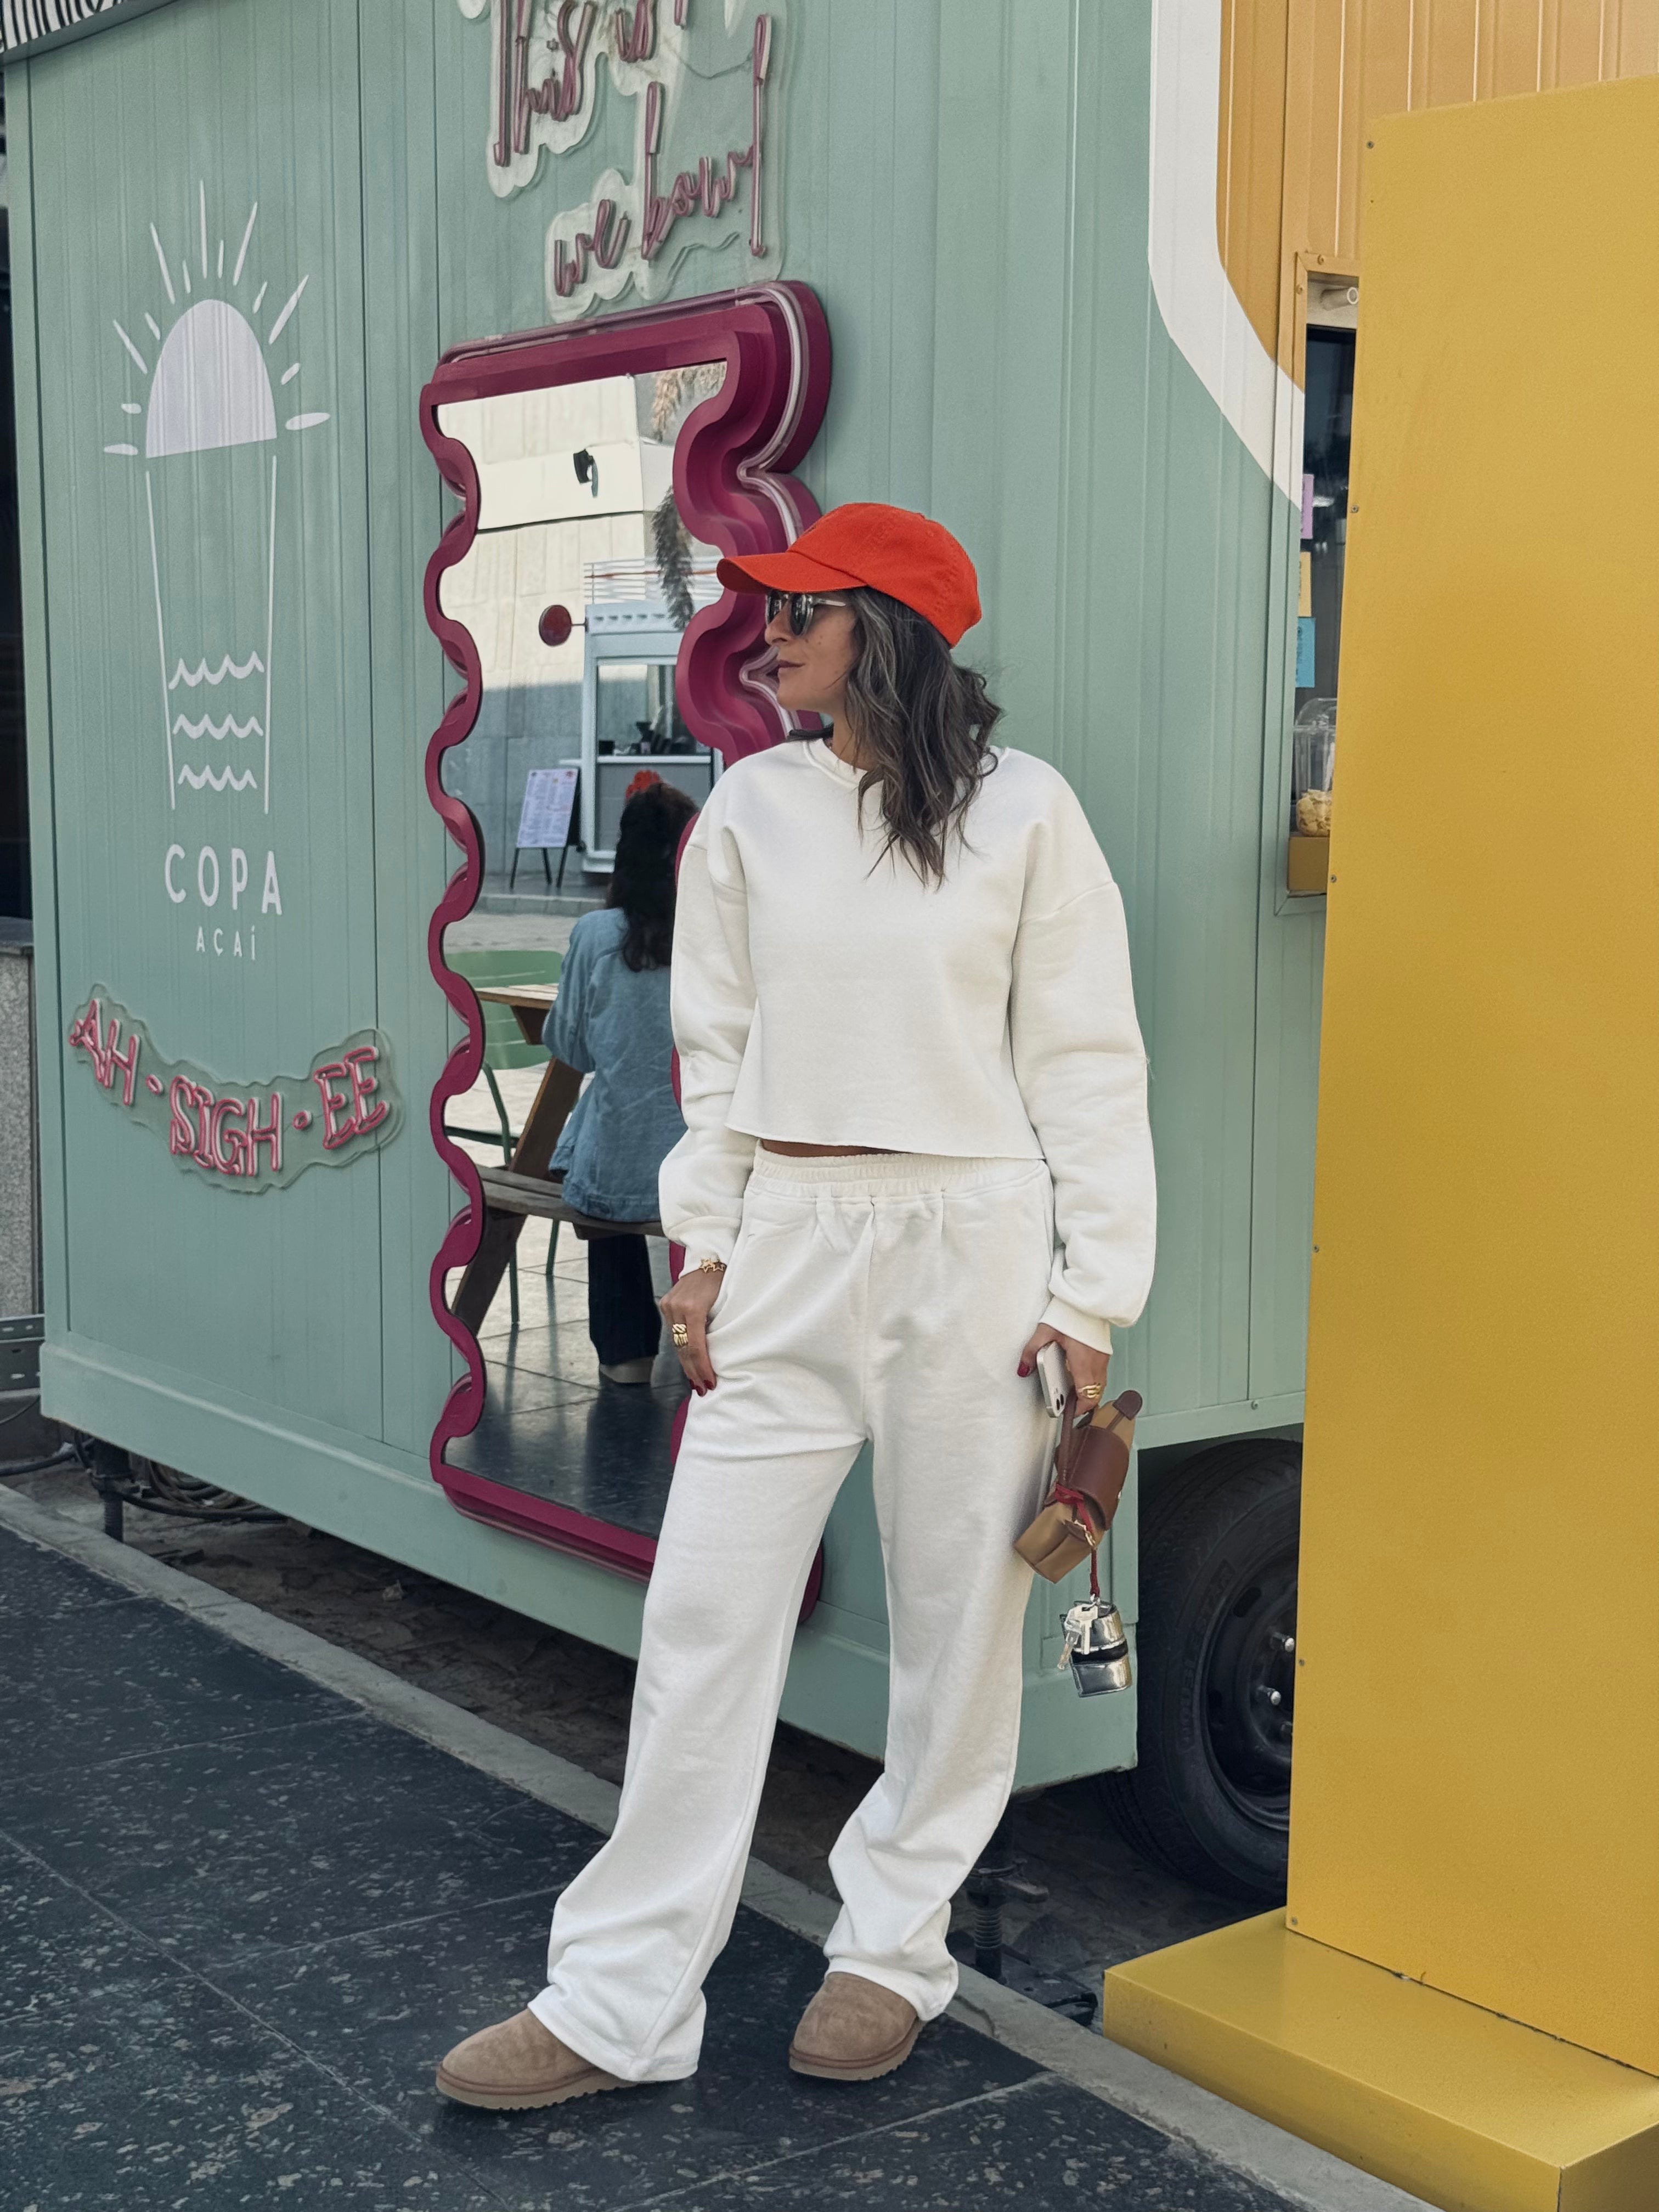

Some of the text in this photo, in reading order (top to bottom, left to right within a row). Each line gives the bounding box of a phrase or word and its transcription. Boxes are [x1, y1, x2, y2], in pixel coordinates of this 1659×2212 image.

[554, 199, 631, 297] we
[165, 844, 283, 915] COPA
[169, 1074, 284, 1176] SIGH
[314, 1047, 387, 1148] EE
